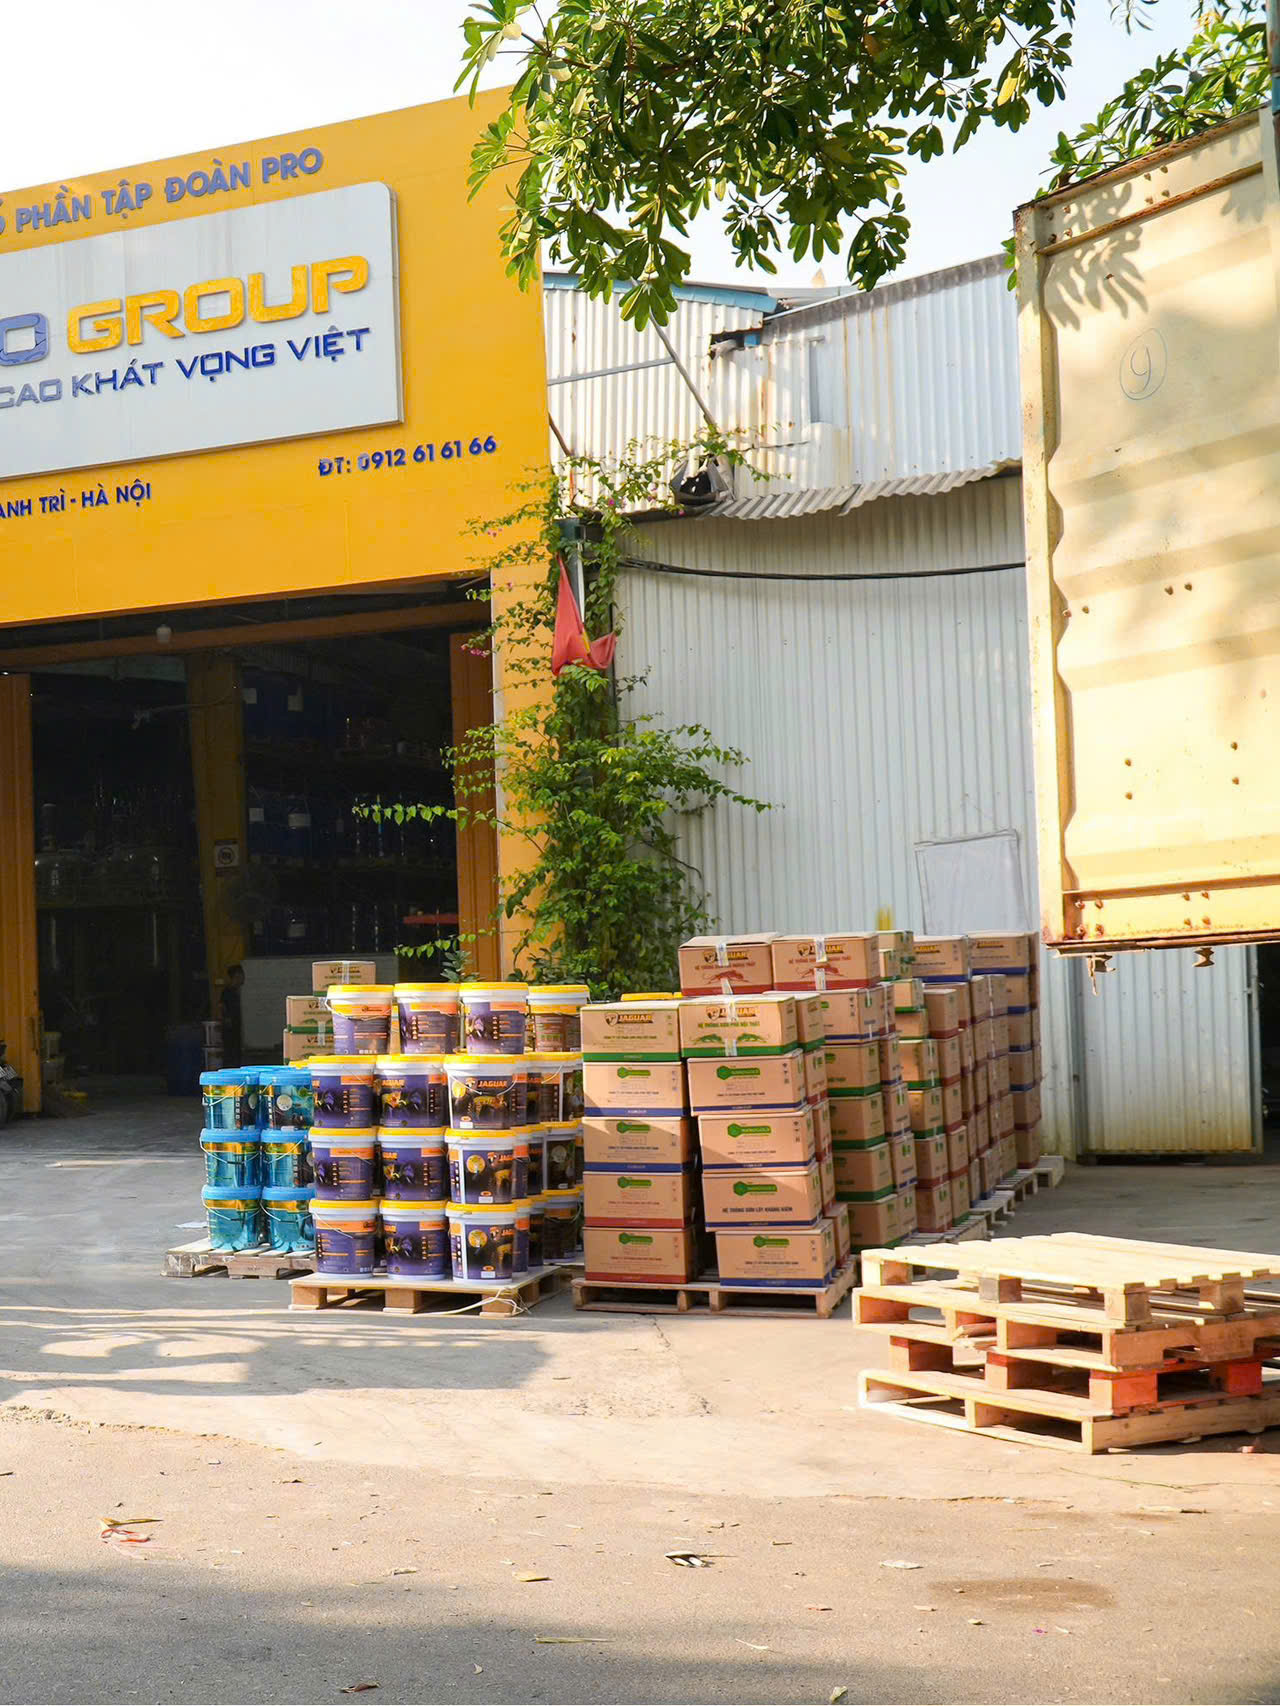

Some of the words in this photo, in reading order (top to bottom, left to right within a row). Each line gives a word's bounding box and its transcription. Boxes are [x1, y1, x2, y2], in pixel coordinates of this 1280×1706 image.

[15, 184, 92, 233] PHẦN
[101, 178, 153, 219] TẬP
[165, 158, 251, 203] ĐOÀN
[262, 147, 324, 184] PRO
[67, 255, 370, 354] GROUP
[72, 358, 165, 399] KHÁT
[175, 343, 276, 383] VỌNG
[286, 325, 371, 363] VIỆT
[318, 457, 352, 476] ĐT:
[357, 448, 406, 471] 0912
[413, 443, 435, 463] 61
[441, 440, 462, 459] 61
[469, 435, 497, 455] 66
[39, 488, 66, 513] TRÌ
[81, 483, 109, 508] HÀ
[116, 478, 151, 506] NỘI
[619, 1014, 653, 1022] JAGUAR
[477, 1079, 508, 1088] JAGUAR
